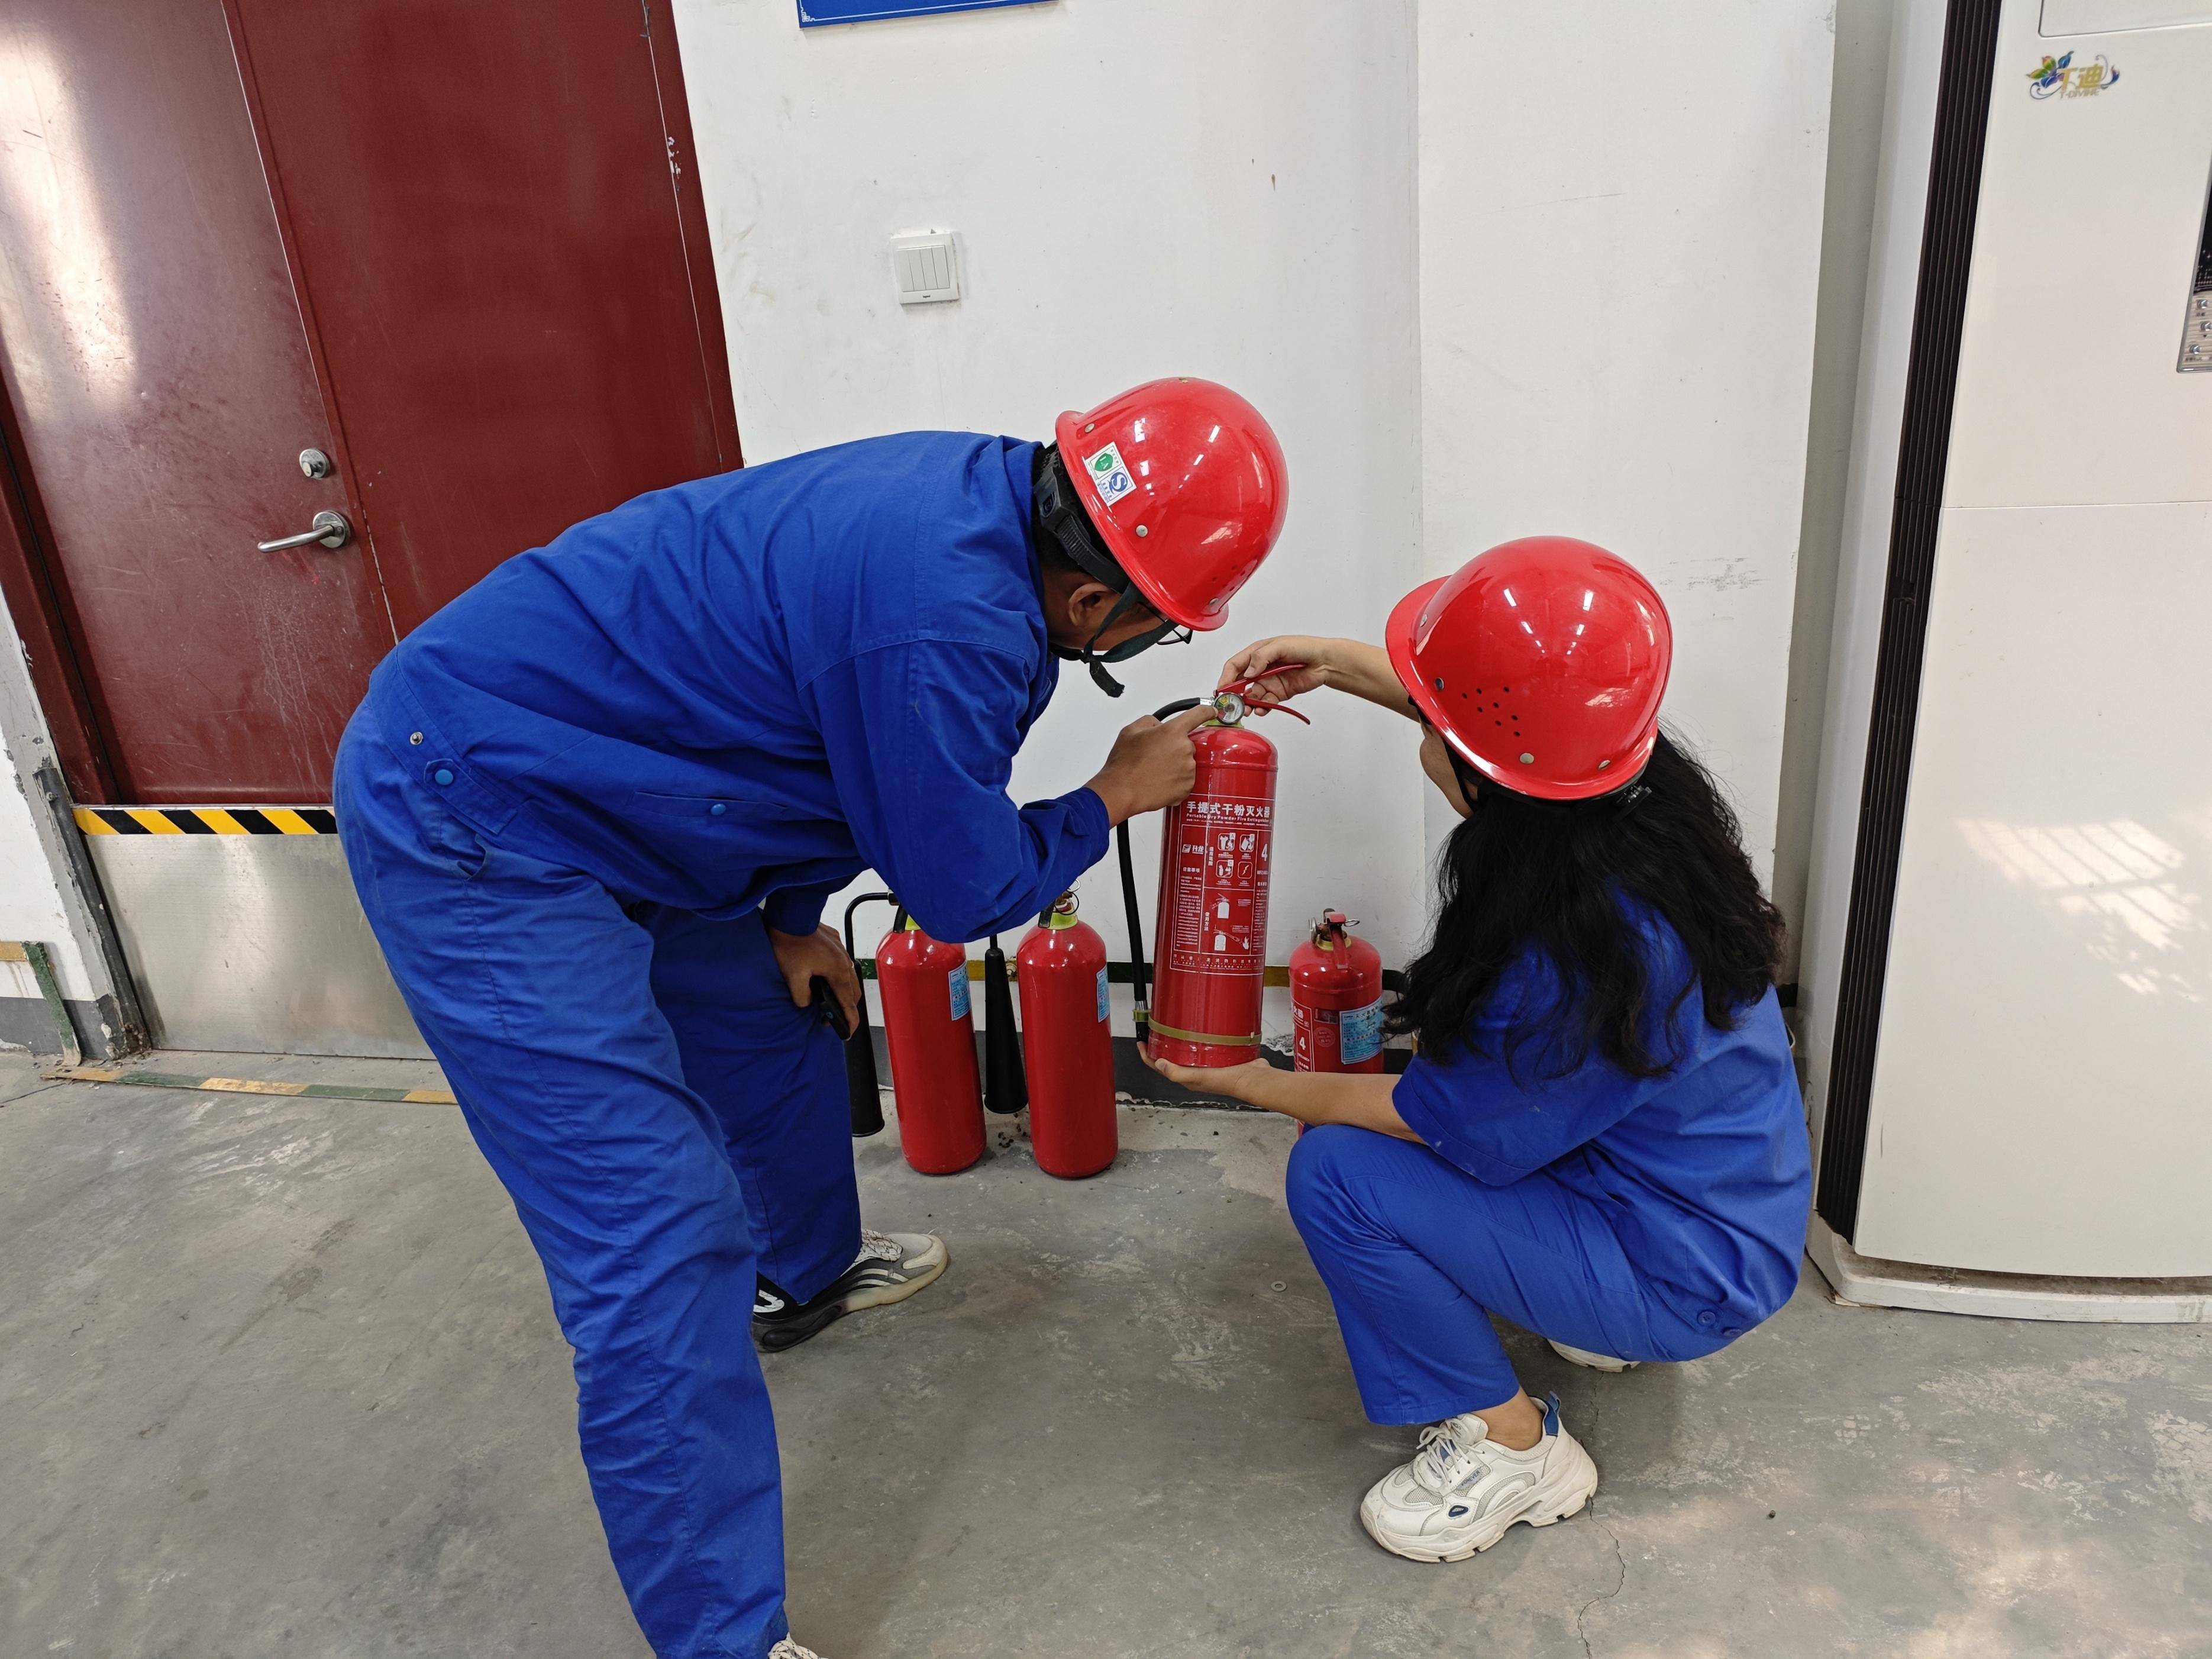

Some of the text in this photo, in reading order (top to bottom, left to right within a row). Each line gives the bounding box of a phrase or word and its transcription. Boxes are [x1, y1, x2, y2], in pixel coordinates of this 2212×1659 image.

[1186, 801, 1270, 818] 手提式干粉灭火器
[1261, 844, 1268, 861] 4
[1299, 1036, 1306, 1050] 4
